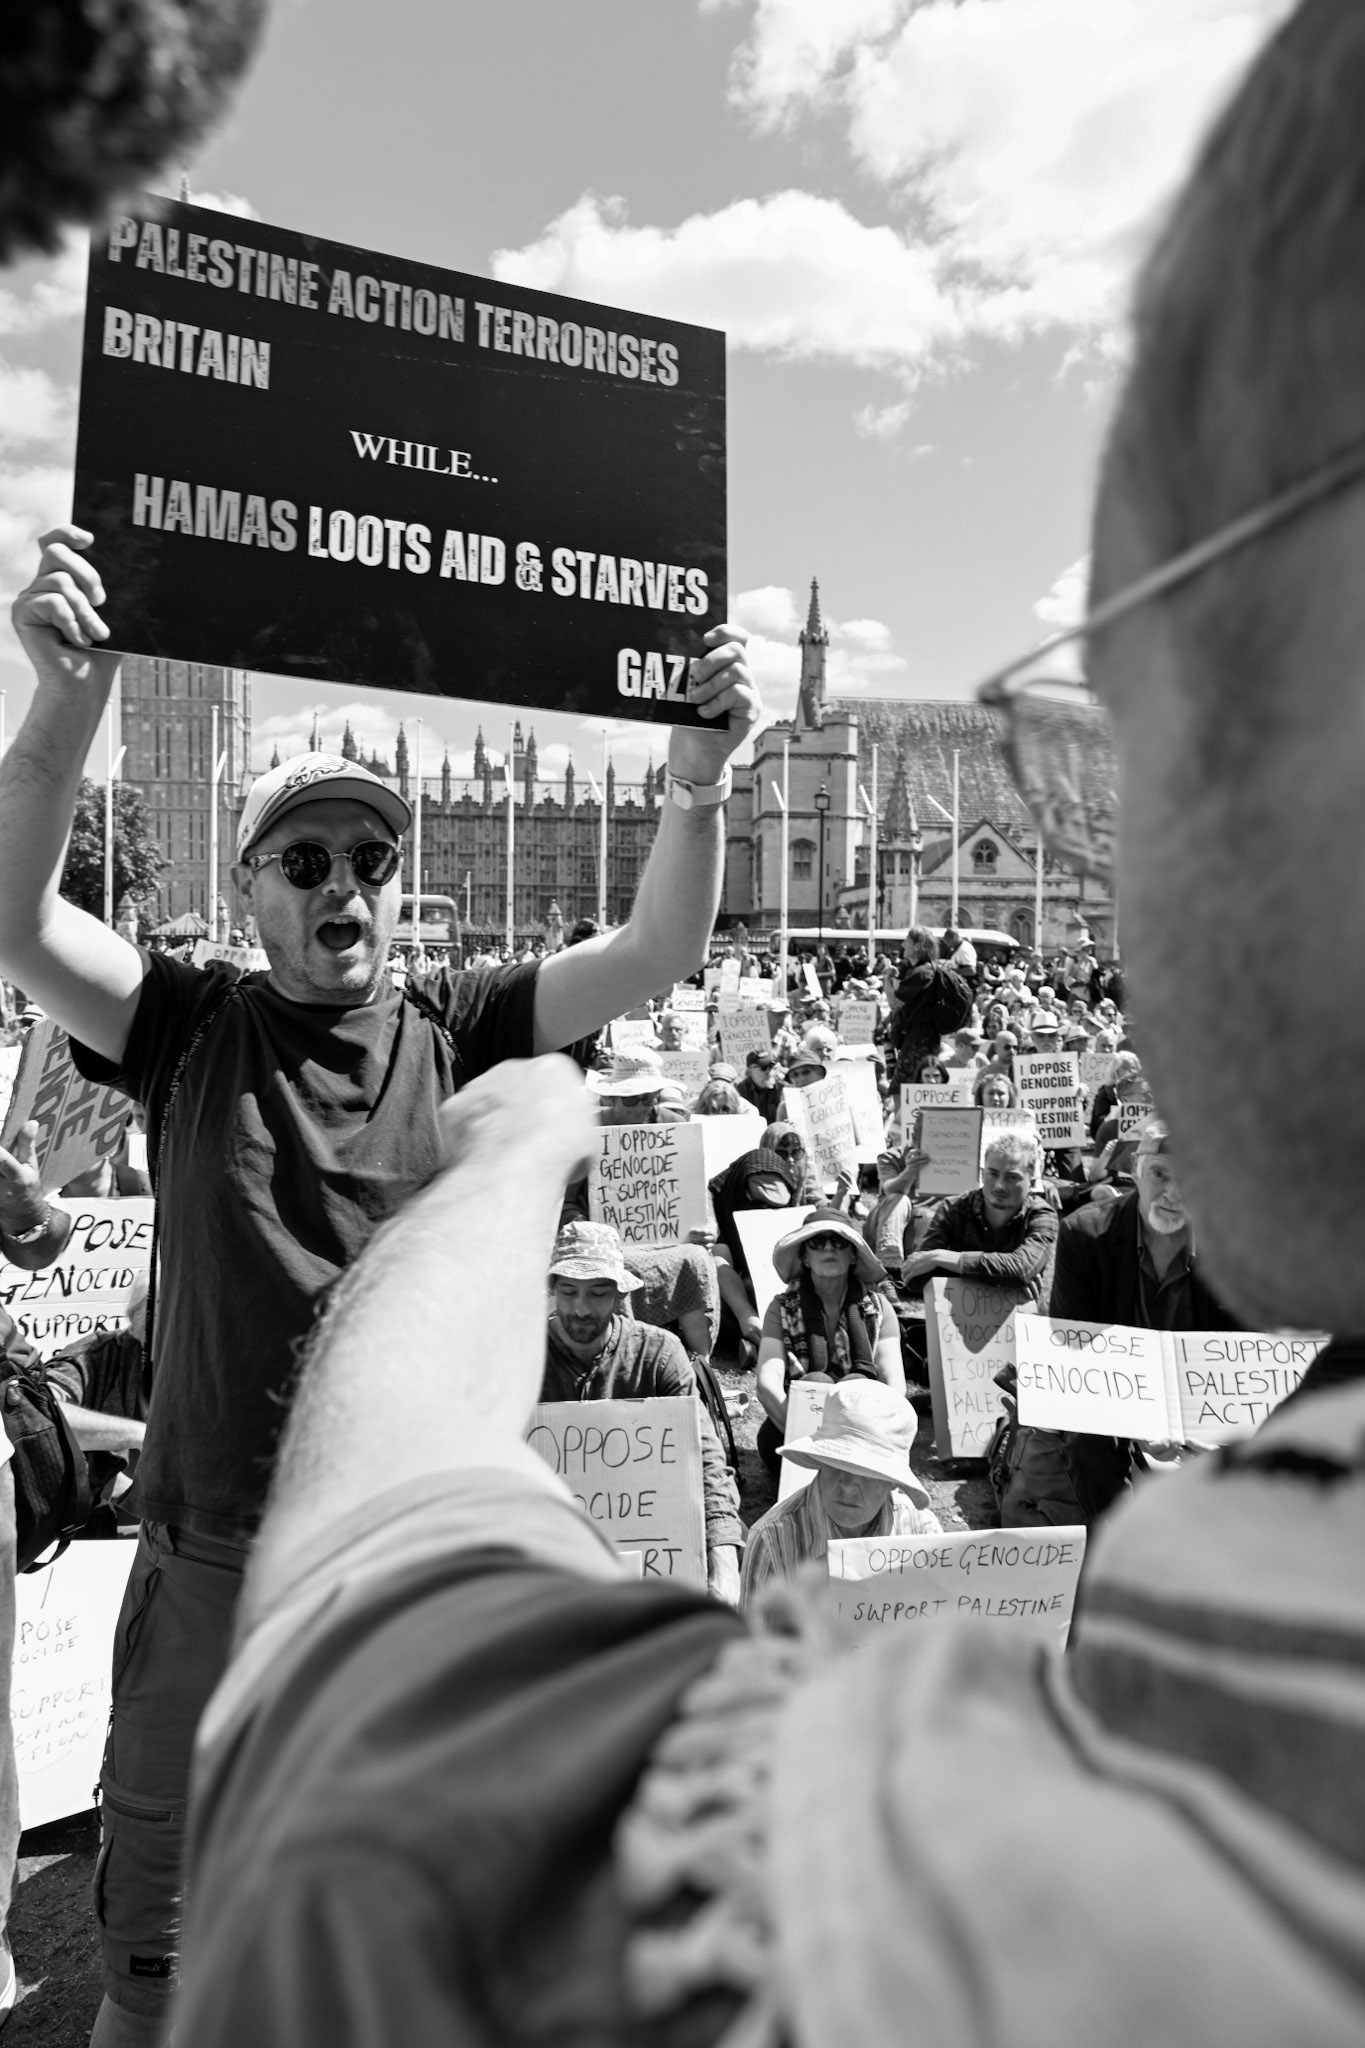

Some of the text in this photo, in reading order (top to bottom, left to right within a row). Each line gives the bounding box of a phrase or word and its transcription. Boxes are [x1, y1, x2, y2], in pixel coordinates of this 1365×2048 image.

[108, 215, 680, 387] PALESTINE ACTION TERRORISES
[102, 305, 271, 390] BRITAIN
[348, 430, 499, 484] WHILE...
[132, 472, 709, 616] HAMAS LOOTS AID & STARVES
[729, 1015, 766, 1028] OPPOSE
[1020, 1062, 1073, 1076] I OPPOSE
[1021, 1076, 1075, 1090] GENOCIDE
[906, 1088, 961, 1105] I OPPOSE
[1021, 1096, 1078, 1110] I SUPPORT
[1036, 1111, 1080, 1124] LESTINE
[1126, 1105, 1155, 1118] OPP
[601, 1127, 676, 1155] I OPPOSE
[1039, 1126, 1072, 1140] CTION
[600, 1152, 678, 1180] GENOCIDE
[598, 1179, 679, 1204] I SUPPORT
[603, 1197, 681, 1229] PALESTINE
[63, 1214, 154, 1252] POSE
[624, 1219, 679, 1242] ACTION
[0, 1263, 134, 1305] GENOCID
[962, 1286, 1037, 1317] OPPOSE
[18, 1313, 128, 1339] SUPPORT
[942, 1323, 1015, 1344] GENOCID
[1025, 1323, 1145, 1358] I OPPOSE
[1181, 1338, 1329, 1364] I SUPPORT
[946, 1358, 1004, 1381] I SUPP
[1016, 1361, 1155, 1401] GENOCIDE
[1187, 1369, 1305, 1397] PALESTIN
[953, 1390, 1008, 1416] PALES
[1199, 1401, 1271, 1425] ACTI
[960, 1420, 997, 1448] ACT
[573, 1490, 657, 1520] CIDE
[841, 1549, 845, 1578] I
[868, 1547, 953, 1574] OPPOSE
[853, 1600, 948, 1623] SUPPORT
[957, 1593, 1065, 1617] PALESTINE
[21, 1615, 77, 1645] POSE
